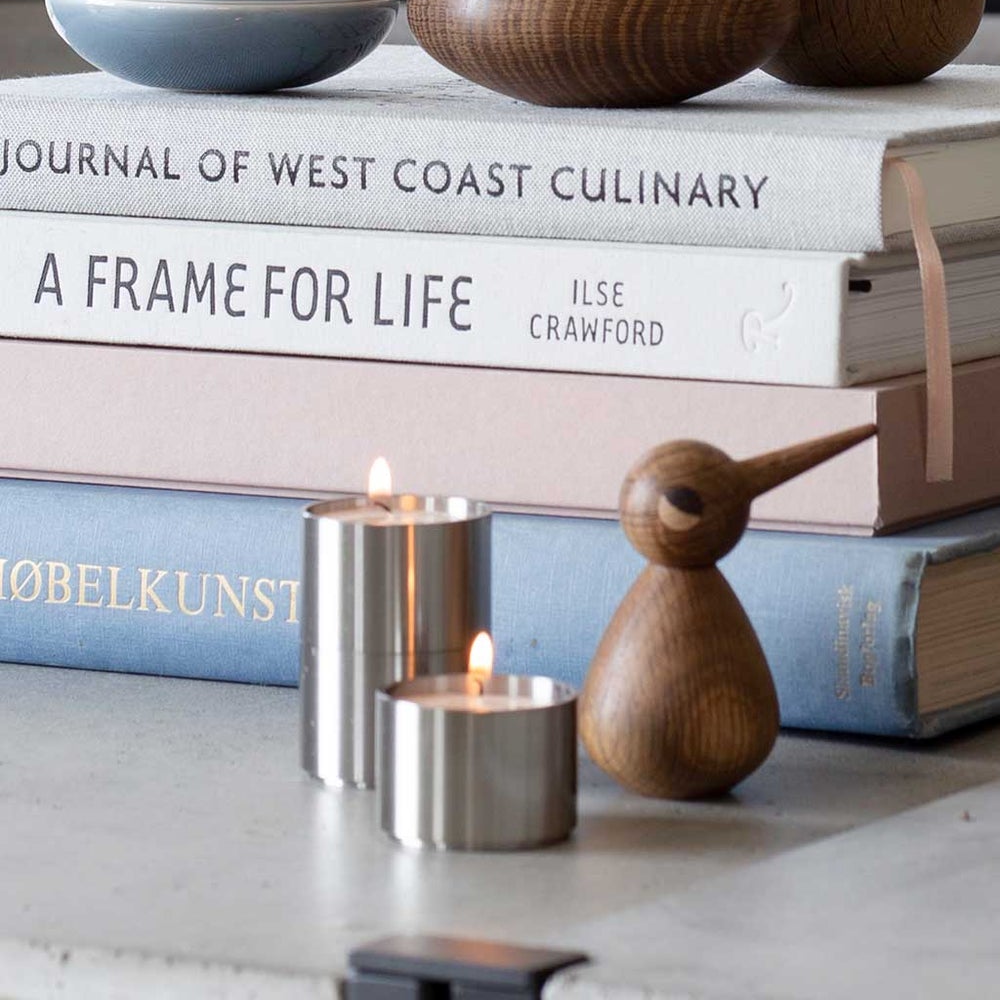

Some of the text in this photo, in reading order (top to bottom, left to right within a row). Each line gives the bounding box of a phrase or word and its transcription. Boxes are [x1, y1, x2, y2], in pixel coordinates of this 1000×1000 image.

[0, 138, 769, 210] JOURNAL OF WEST COAST CULINARY
[34, 252, 474, 332] A FRAME FOR LIFE
[572, 278, 625, 308] ILSE
[529, 313, 665, 347] CRAWFORD
